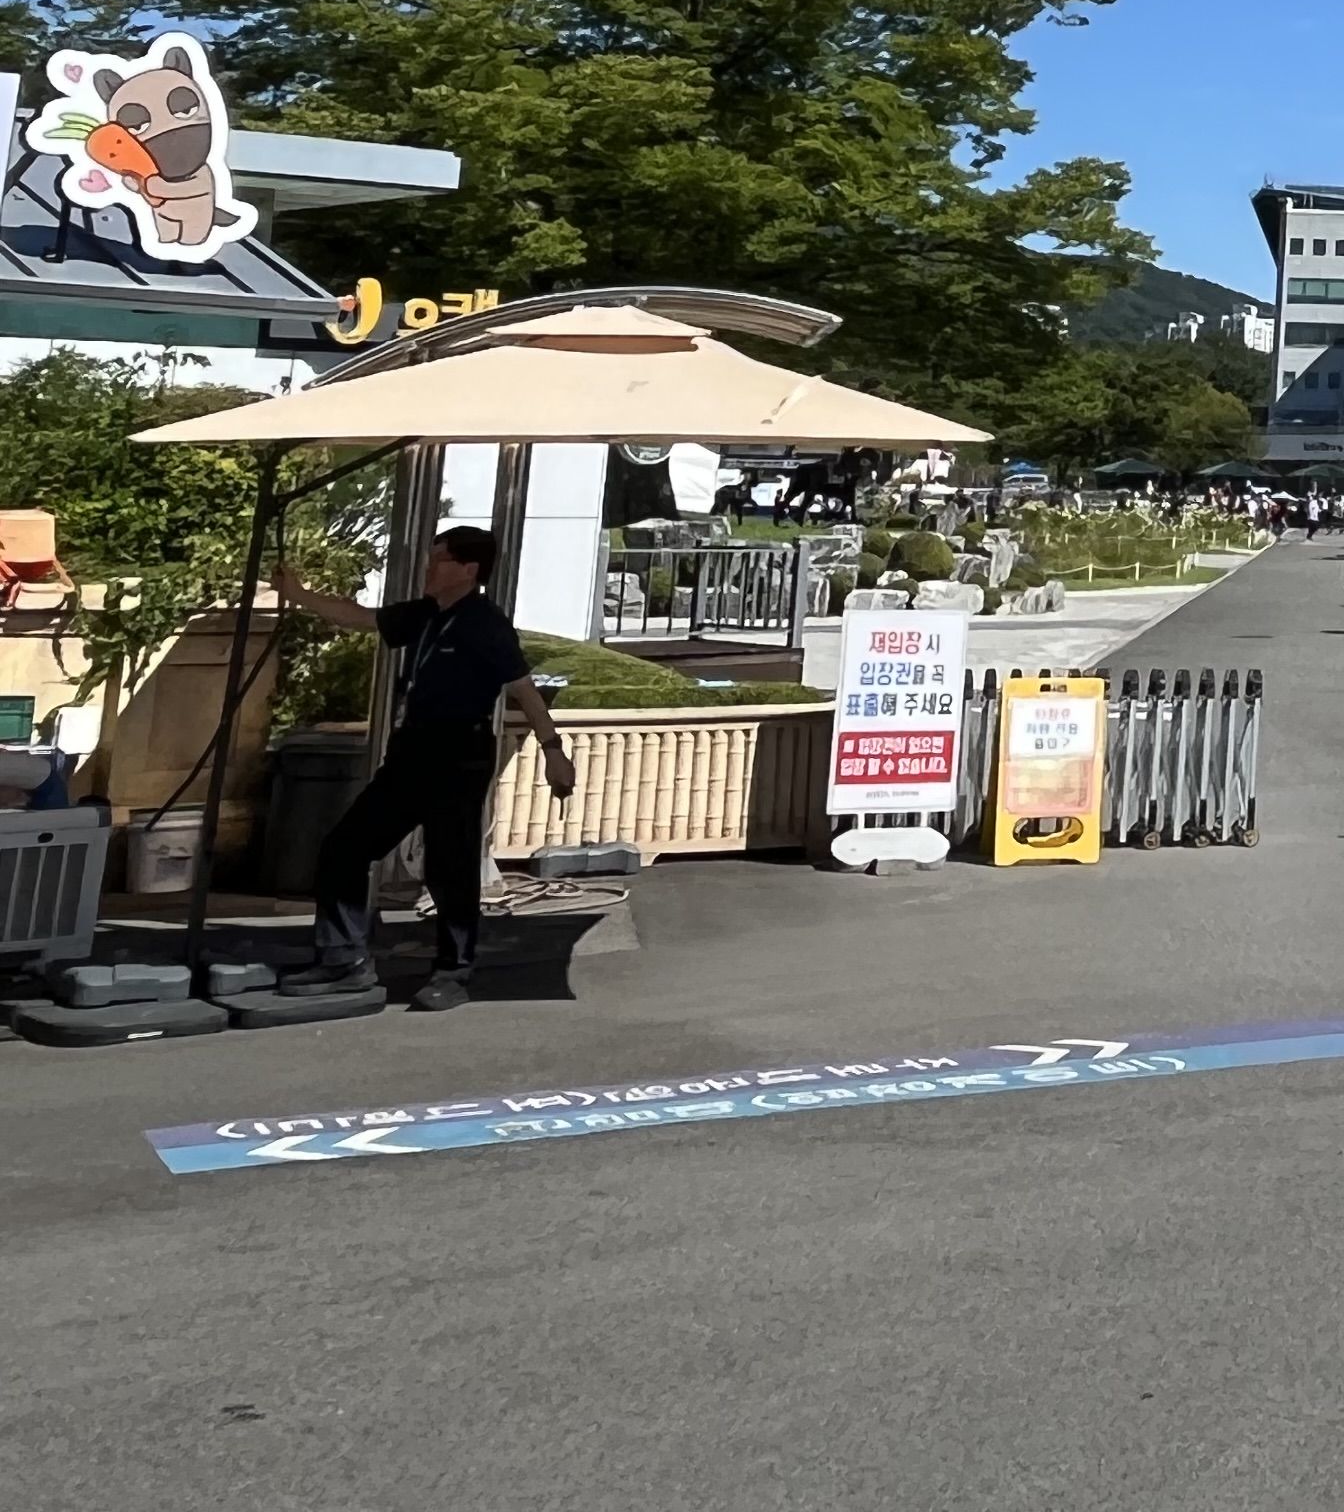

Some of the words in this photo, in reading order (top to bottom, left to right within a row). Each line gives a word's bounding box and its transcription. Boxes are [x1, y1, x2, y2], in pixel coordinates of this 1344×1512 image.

[869, 631, 922, 655] 재입장
[925, 633, 941, 655] 시
[903, 692, 953, 717] 주세요
